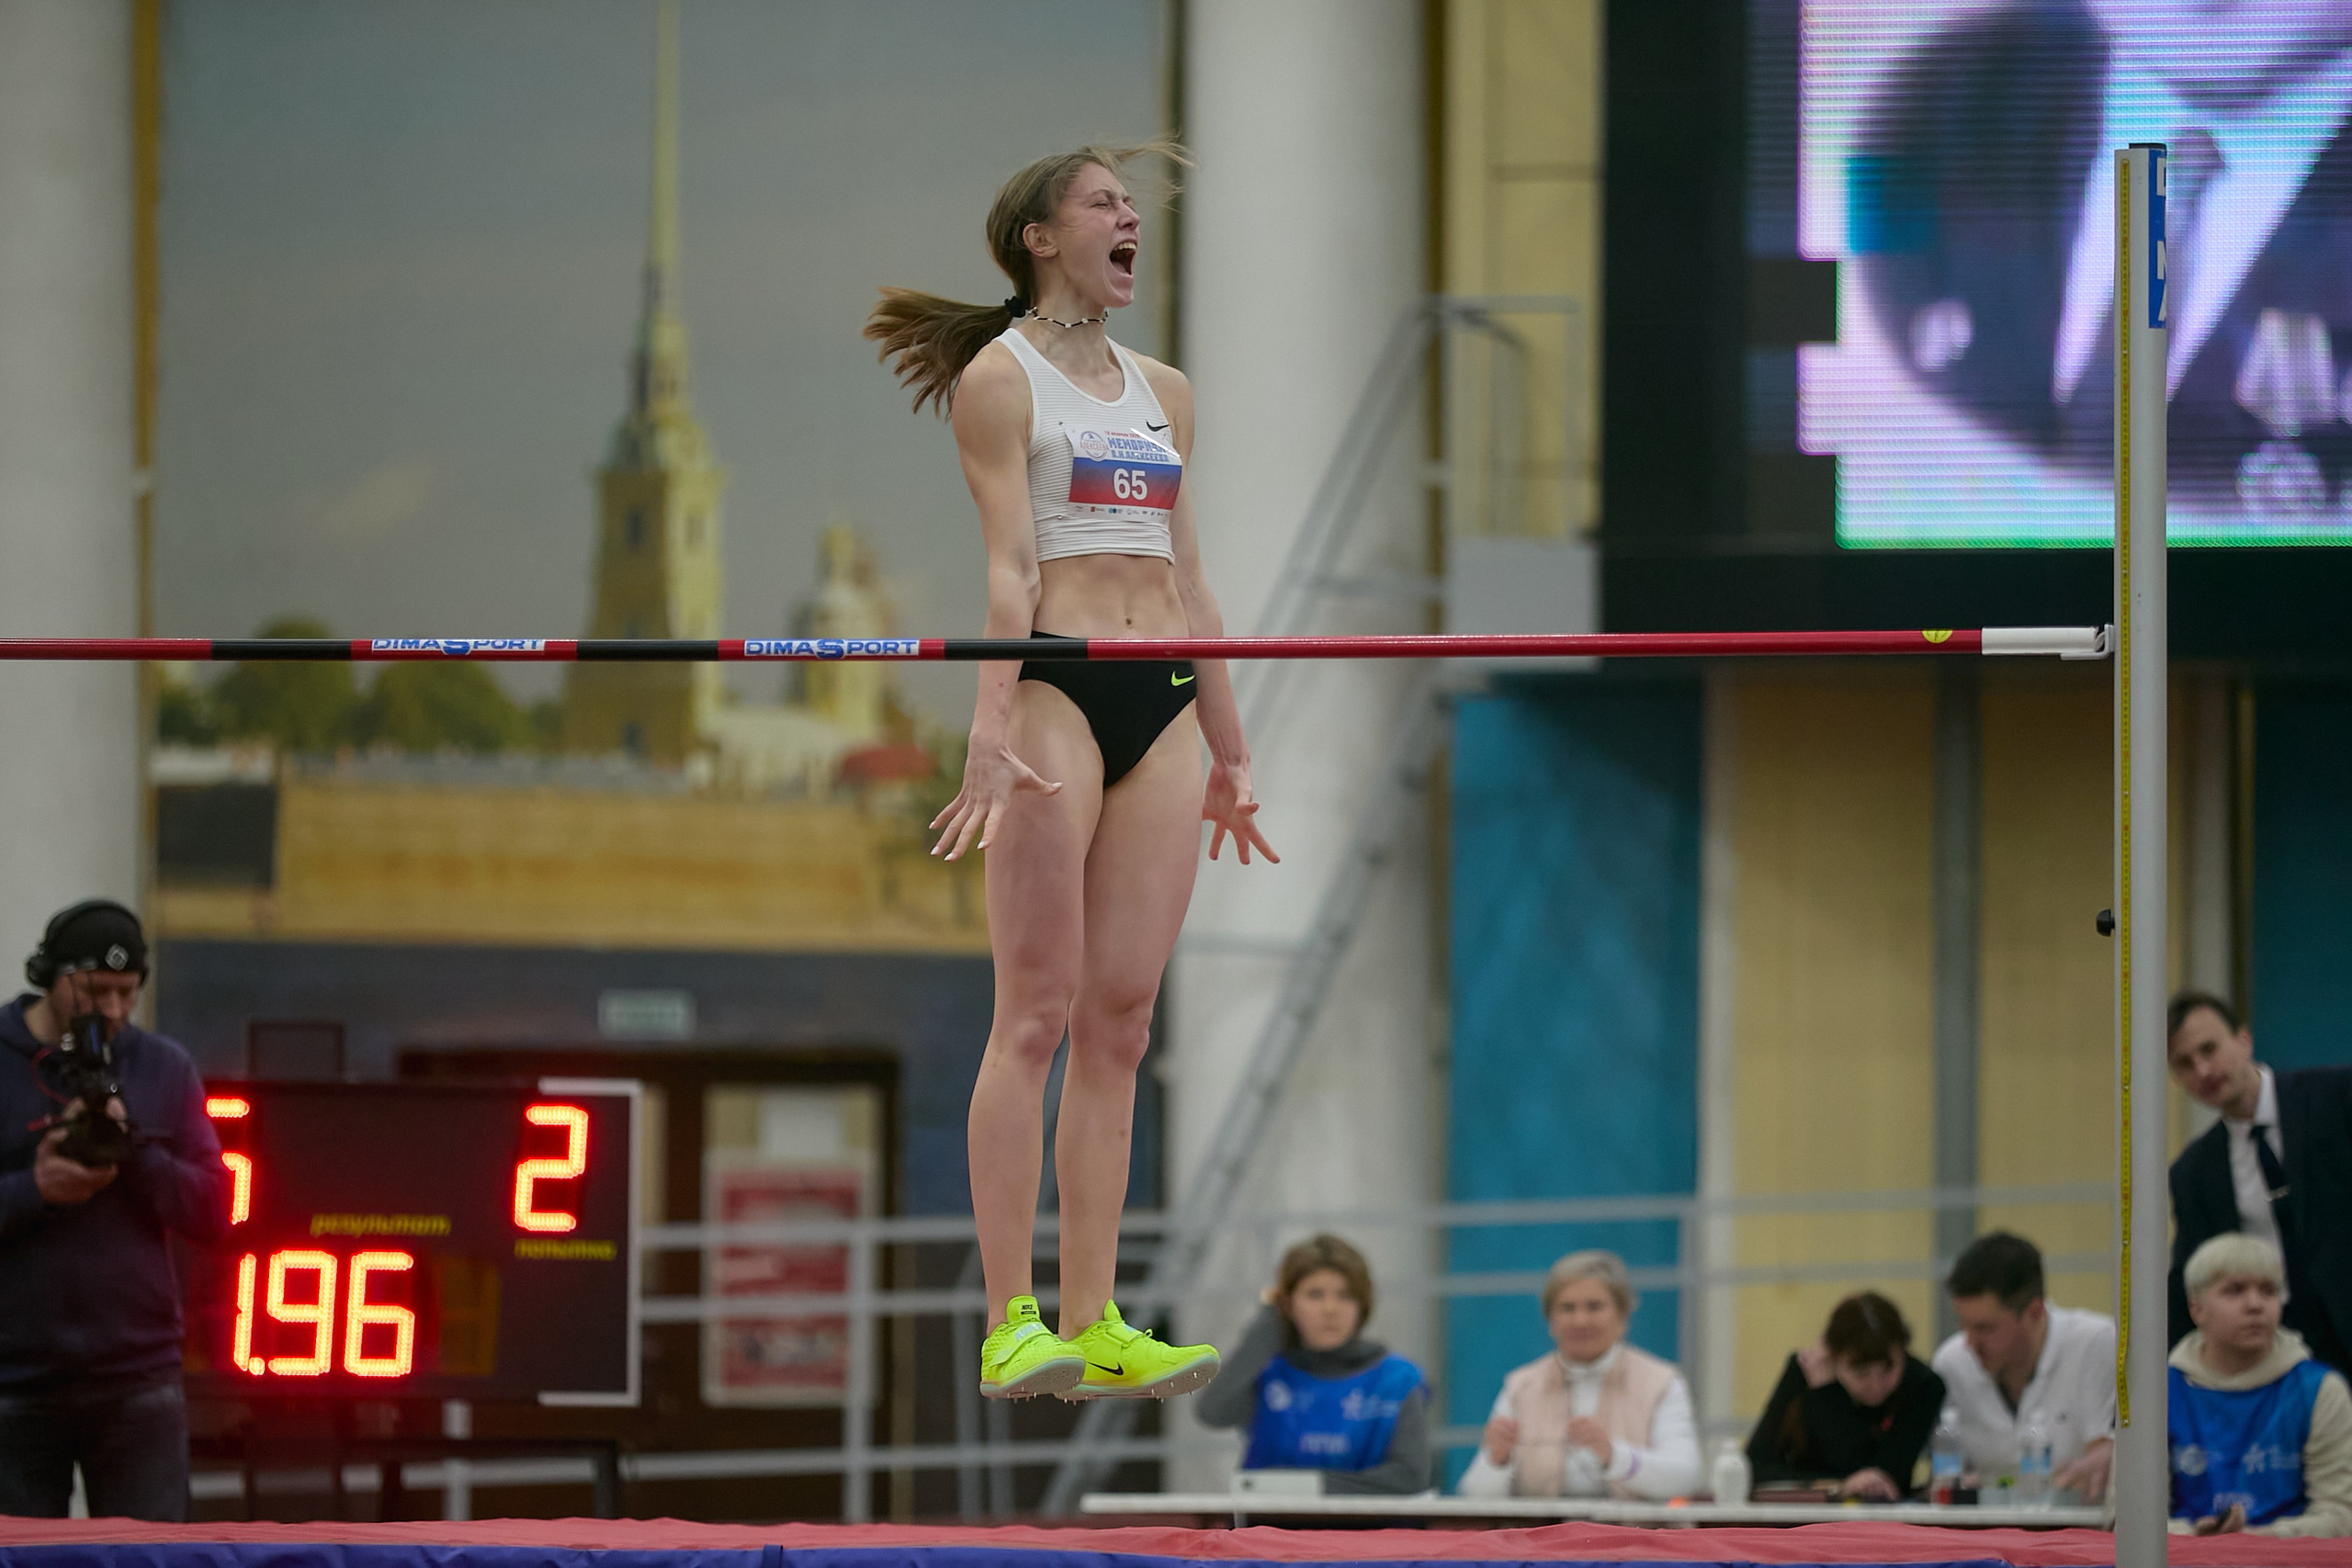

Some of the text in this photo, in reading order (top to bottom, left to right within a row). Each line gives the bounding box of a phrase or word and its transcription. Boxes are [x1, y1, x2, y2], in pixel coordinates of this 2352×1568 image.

[1113, 468, 1148, 501] 65
[373, 638, 539, 655] DIMASPORT
[745, 638, 918, 660] DIMASPORT
[513, 1103, 590, 1232] 2
[232, 1249, 415, 1377] 1.96
